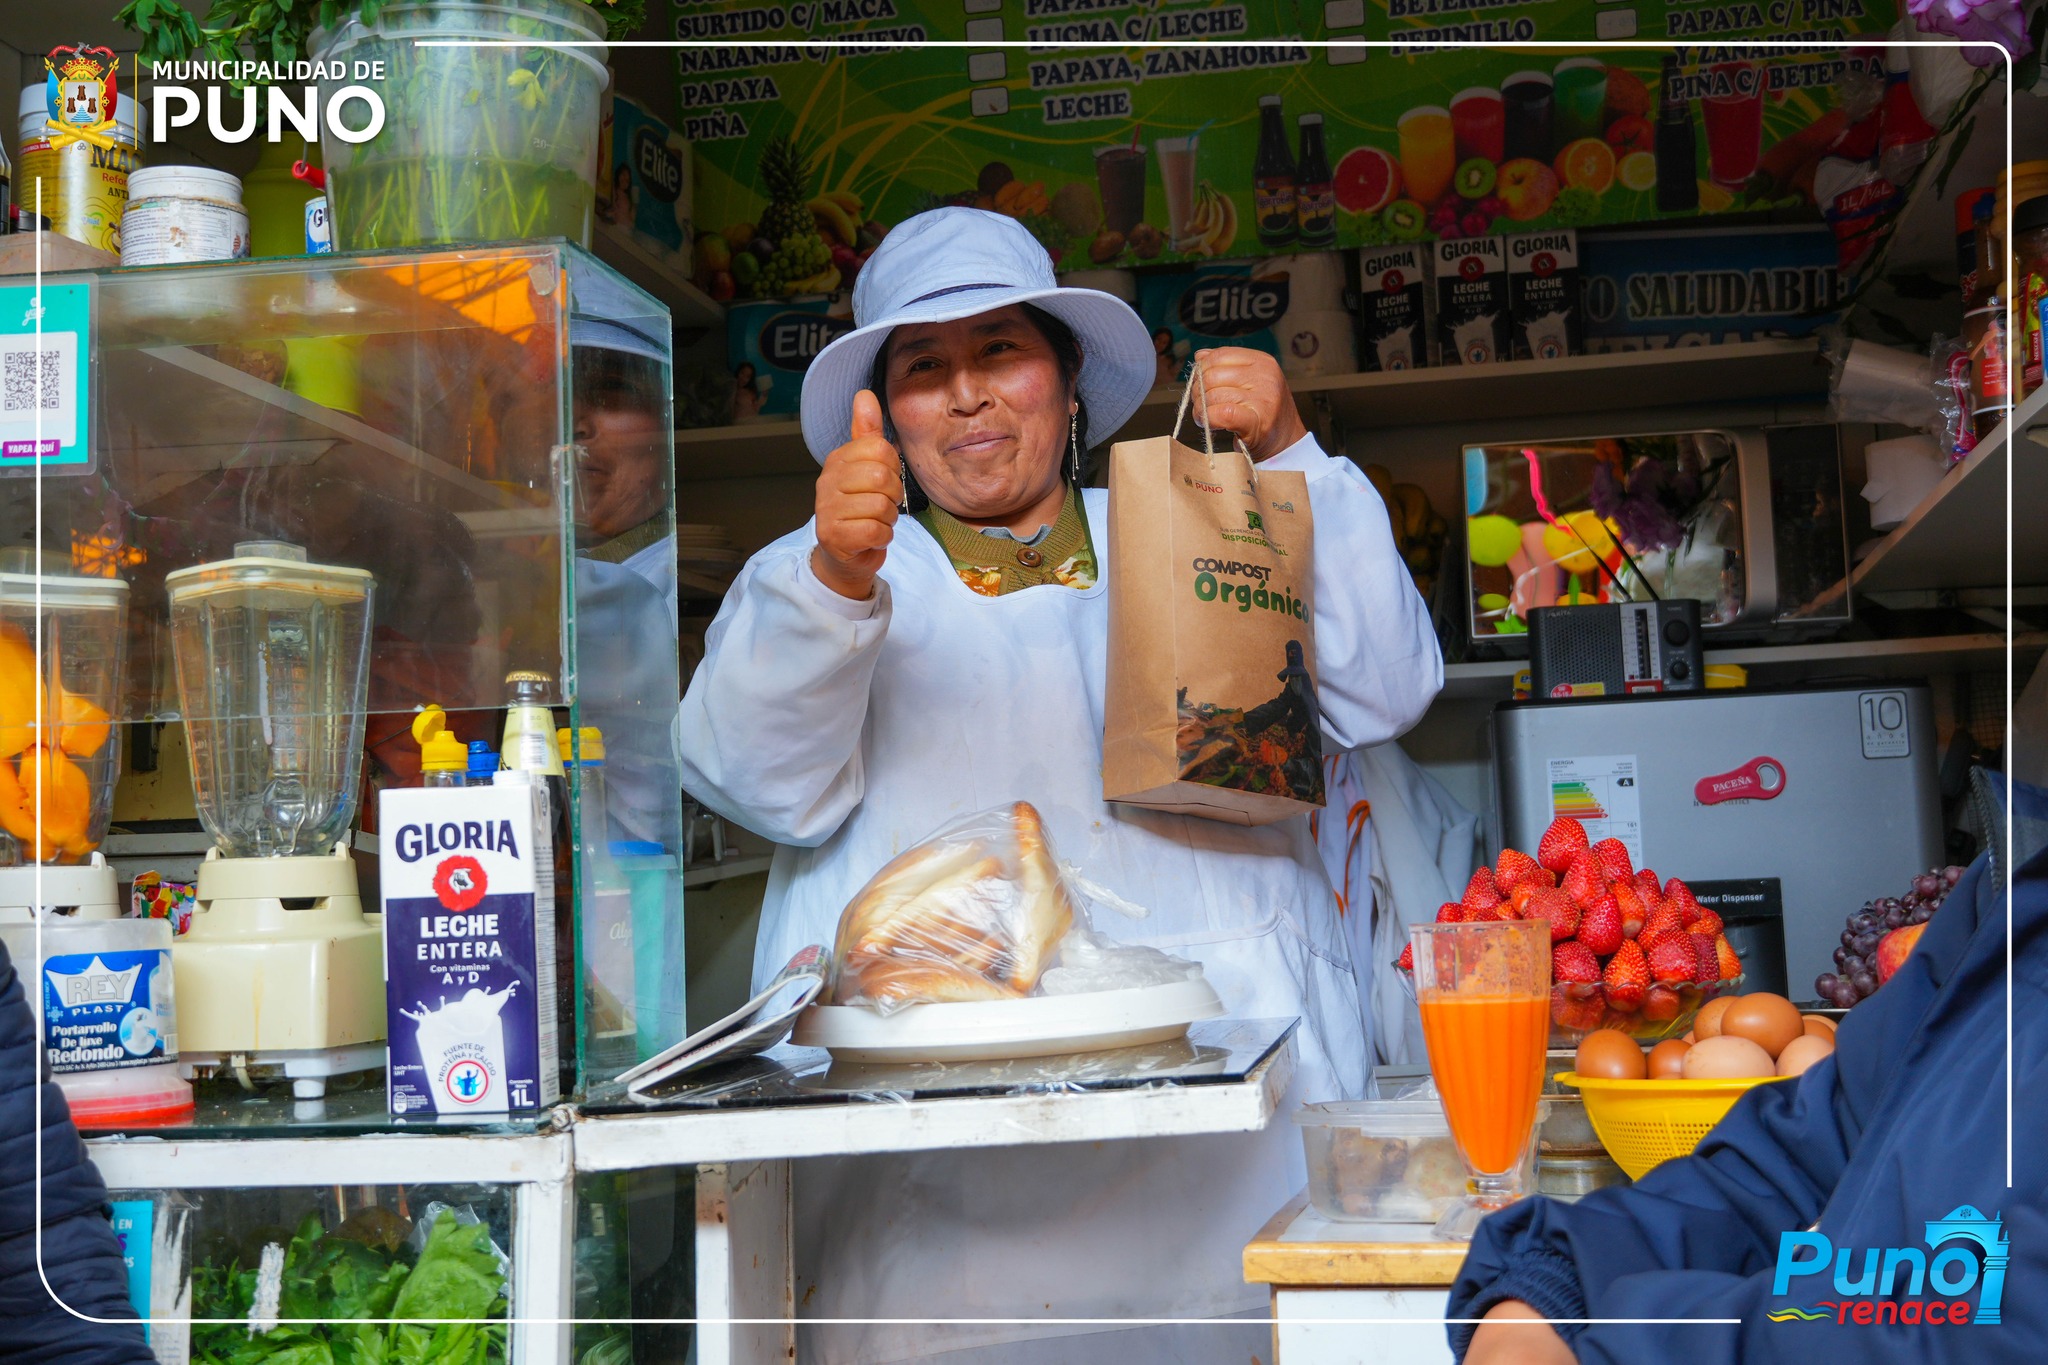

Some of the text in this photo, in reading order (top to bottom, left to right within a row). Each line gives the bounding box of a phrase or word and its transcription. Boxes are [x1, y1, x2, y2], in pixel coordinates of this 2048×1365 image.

[678, 0, 895, 38] SURTIDO C/ MACA
[1029, 9, 1244, 50] LUCMA C/ LECHE
[1668, 5, 1763, 35] PAPAYA
[1769, 1, 1793, 28] C/
[1390, 19, 1534, 54] PEPINILLO
[1697, 28, 1848, 64] ZANAHORIA
[680, 28, 925, 72] NARANJA C/ HUEVO
[1031, 38, 1308, 86] PAPAYA, ZANAHORIA
[683, 78, 778, 105] PAPAYA
[1671, 70, 1731, 99] PIÑA
[1736, 68, 1762, 96] C/
[1046, 93, 1129, 121] LECHE
[685, 111, 745, 138] PIÑA
[641, 138, 679, 195] Elite
[1441, 239, 1499, 261] GLORIA
[1513, 235, 1571, 257] GLORIA
[1365, 251, 1416, 276] GLORIA
[1453, 282, 1491, 294] LECHE
[1524, 289, 1564, 301] ENTERA
[1525, 277, 1563, 291] LECHE
[1628, 267, 1849, 317] SALUDABLE
[1193, 287, 1278, 324] Elite
[1376, 293, 1409, 309] LECHE
[1452, 293, 1492, 304] ENTERA
[1375, 305, 1411, 319] ENTERA
[8, 444, 32, 454] YAPEA
[1195, 482, 1223, 494] PUNO
[1193, 558, 1271, 581] COMPOST
[1195, 572, 1309, 624] Orgánico
[1864, 696, 1903, 731] 10
[1712, 776, 1752, 793] PACEÑA
[395, 820, 520, 863] GLORIA
[1722, 894, 1763, 902] Dispenser
[420, 914, 499, 938] LECHE
[417, 941, 502, 960] ENTERA
[430, 963, 490, 973] Con vitaminas
[442, 972, 480, 985] A y D
[67, 973, 131, 1005] REY
[72, 1004, 124, 1016] PLAST
[52, 1022, 117, 1036] Portarrollo
[49, 1043, 124, 1065] Redondo
[61, 1037, 77, 1048] De
[443, 1043, 485, 1057] FUENTE DE
[438, 1052, 466, 1082] PROTEÍNA
[474, 1052, 496, 1077] CALCIO
[511, 1089, 534, 1107] 1L
